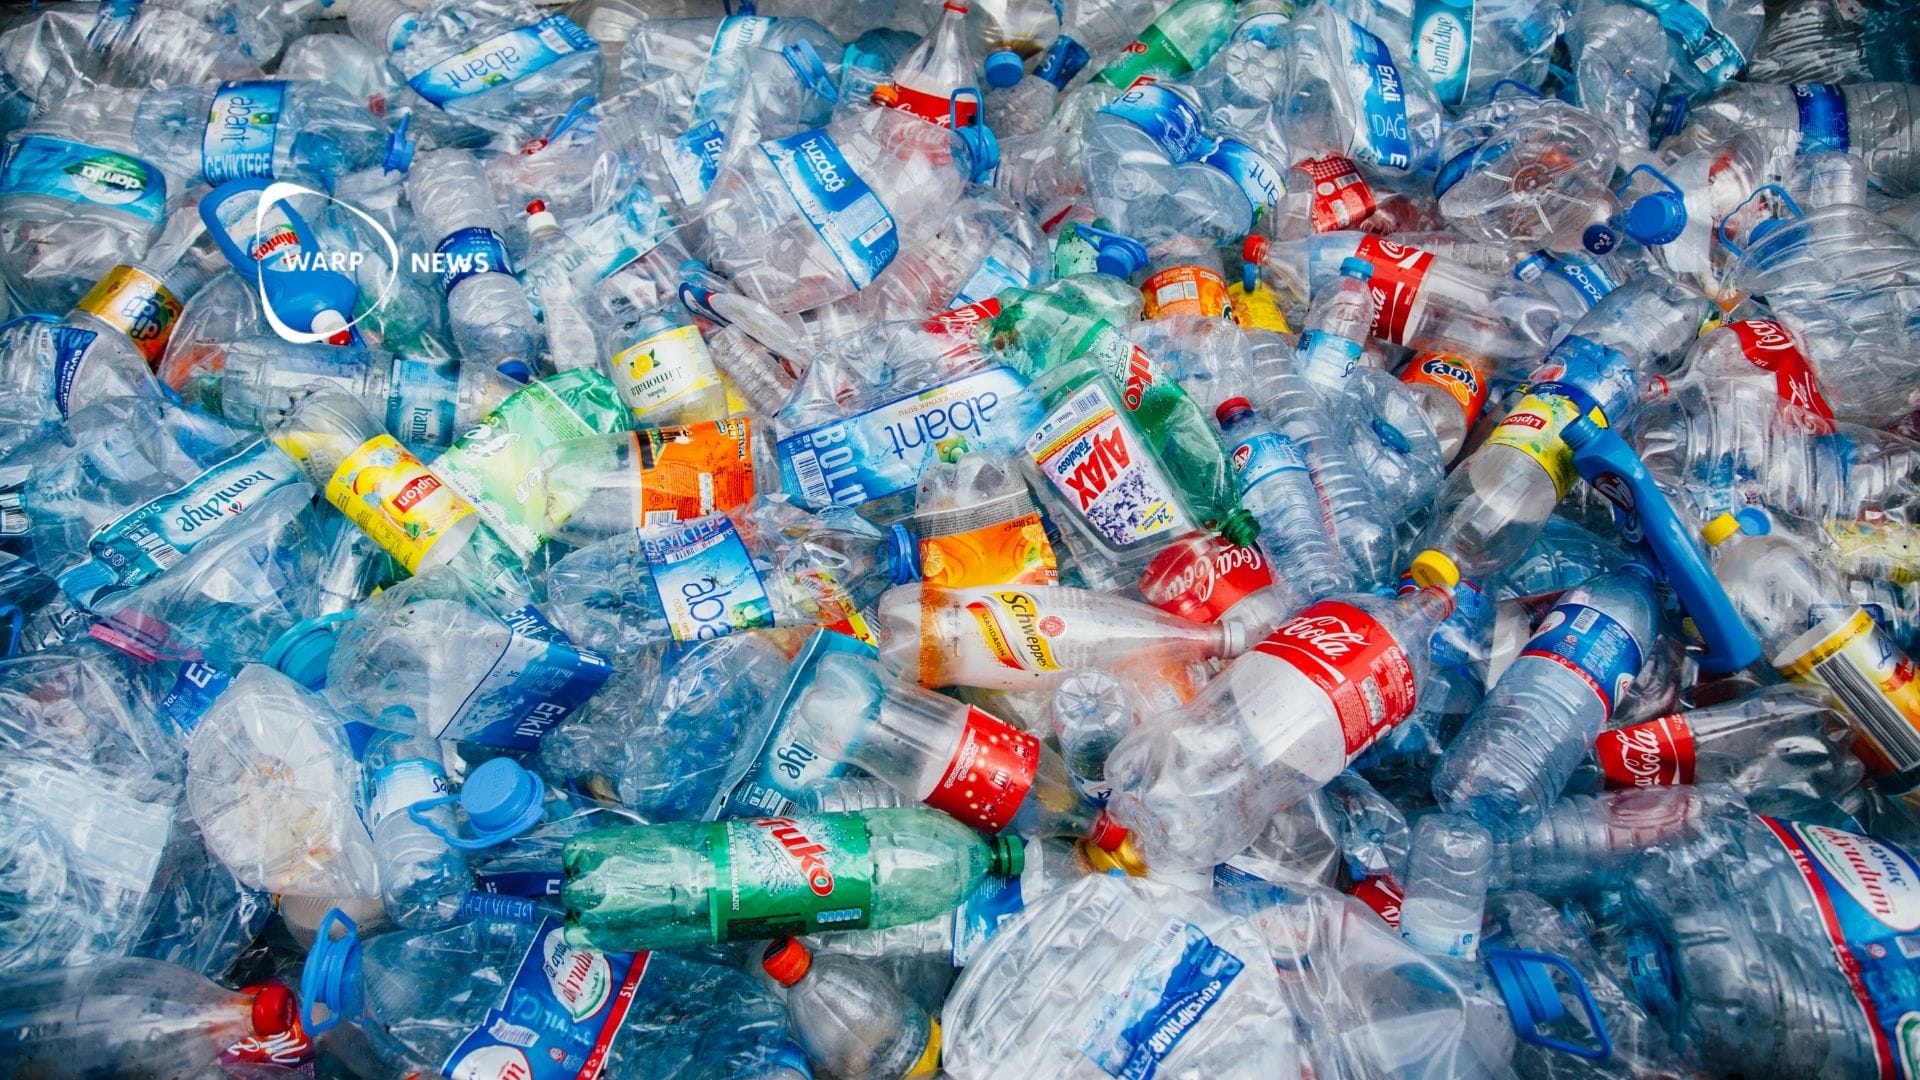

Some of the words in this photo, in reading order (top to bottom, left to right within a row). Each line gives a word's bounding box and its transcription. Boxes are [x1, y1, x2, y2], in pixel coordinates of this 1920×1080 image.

[444, 46, 520, 89] abant
[1377, 64, 1401, 102] Erikli
[221, 96, 259, 142] abant
[82, 165, 141, 190] damla
[253, 231, 300, 261] Mintax
[1421, 358, 1478, 394] Fanta
[885, 391, 998, 460] abant
[898, 404, 920, 417] SUYU
[812, 423, 868, 506] BOLU
[1057, 436, 1092, 475] Fabuloso
[1065, 426, 1131, 511] AJAX
[176, 470, 276, 532] hamidiye
[399, 476, 439, 506] Lipton
[1154, 508, 1170, 523] 24
[1165, 544, 1261, 602] Coca-Cola
[682, 577, 732, 640] aba
[981, 613, 1007, 658] MANDARIN
[164, 694, 178, 708] 10L
[515, 702, 566, 738] Erikli
[1816, 826, 1891, 914] akyudum
[1869, 845, 1906, 890] aytaç
[732, 888, 740, 911] GAZOZ
